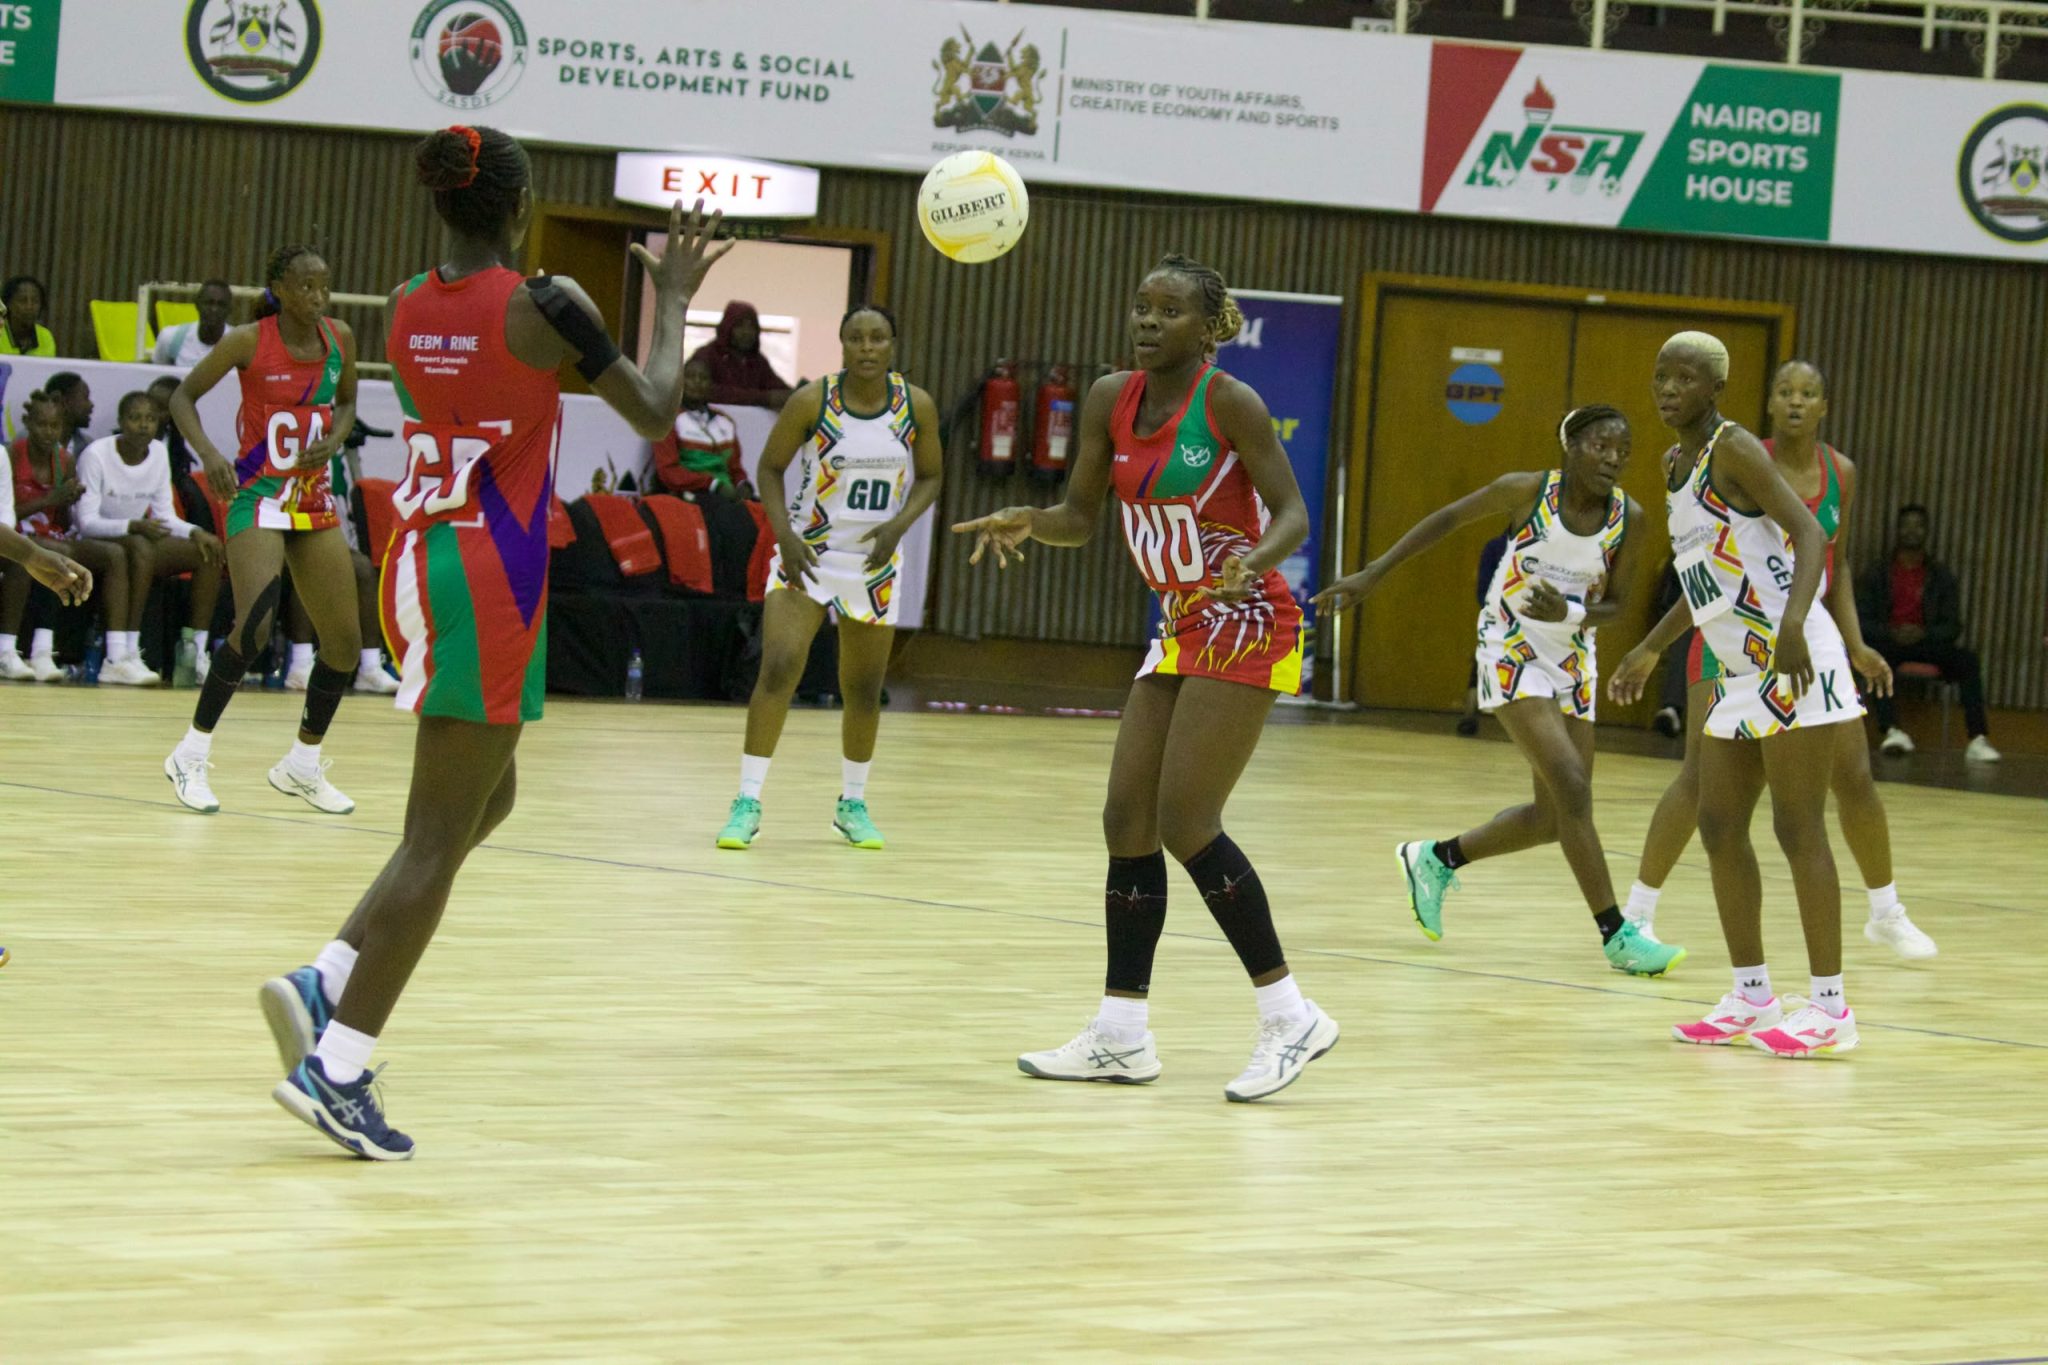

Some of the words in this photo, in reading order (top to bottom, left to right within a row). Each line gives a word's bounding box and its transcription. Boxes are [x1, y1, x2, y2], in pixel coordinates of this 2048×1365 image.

[538, 37, 644, 65] SPORTS,
[656, 47, 720, 68] ARTS
[732, 52, 748, 70] &
[760, 54, 854, 79] SOCIAL
[559, 65, 749, 97] DEVELOPMENT
[760, 80, 829, 103] FUND
[1071, 77, 1145, 94] MINISTRY
[1149, 83, 1172, 97] OF
[1176, 85, 1230, 101] YOUTH
[1234, 90, 1305, 110] AFFAIRS,
[1069, 94, 1148, 113] CREATIVE
[1152, 101, 1233, 120] ECONOMY
[1236, 109, 1271, 124] AND
[1275, 112, 1340, 130] SPORTS
[1691, 102, 1822, 136] NAIROBI
[1008, 148, 1046, 160] KENYA
[1687, 138, 1808, 172] SPORTS
[662, 167, 770, 199] EXIT
[1686, 174, 1793, 207] HOUSE
[930, 192, 1006, 223] GILBERT
[846, 479, 891, 511] GD
[1111, 500, 1204, 585] WD
[1681, 560, 1723, 610] WA
[1820, 669, 1843, 713] K
